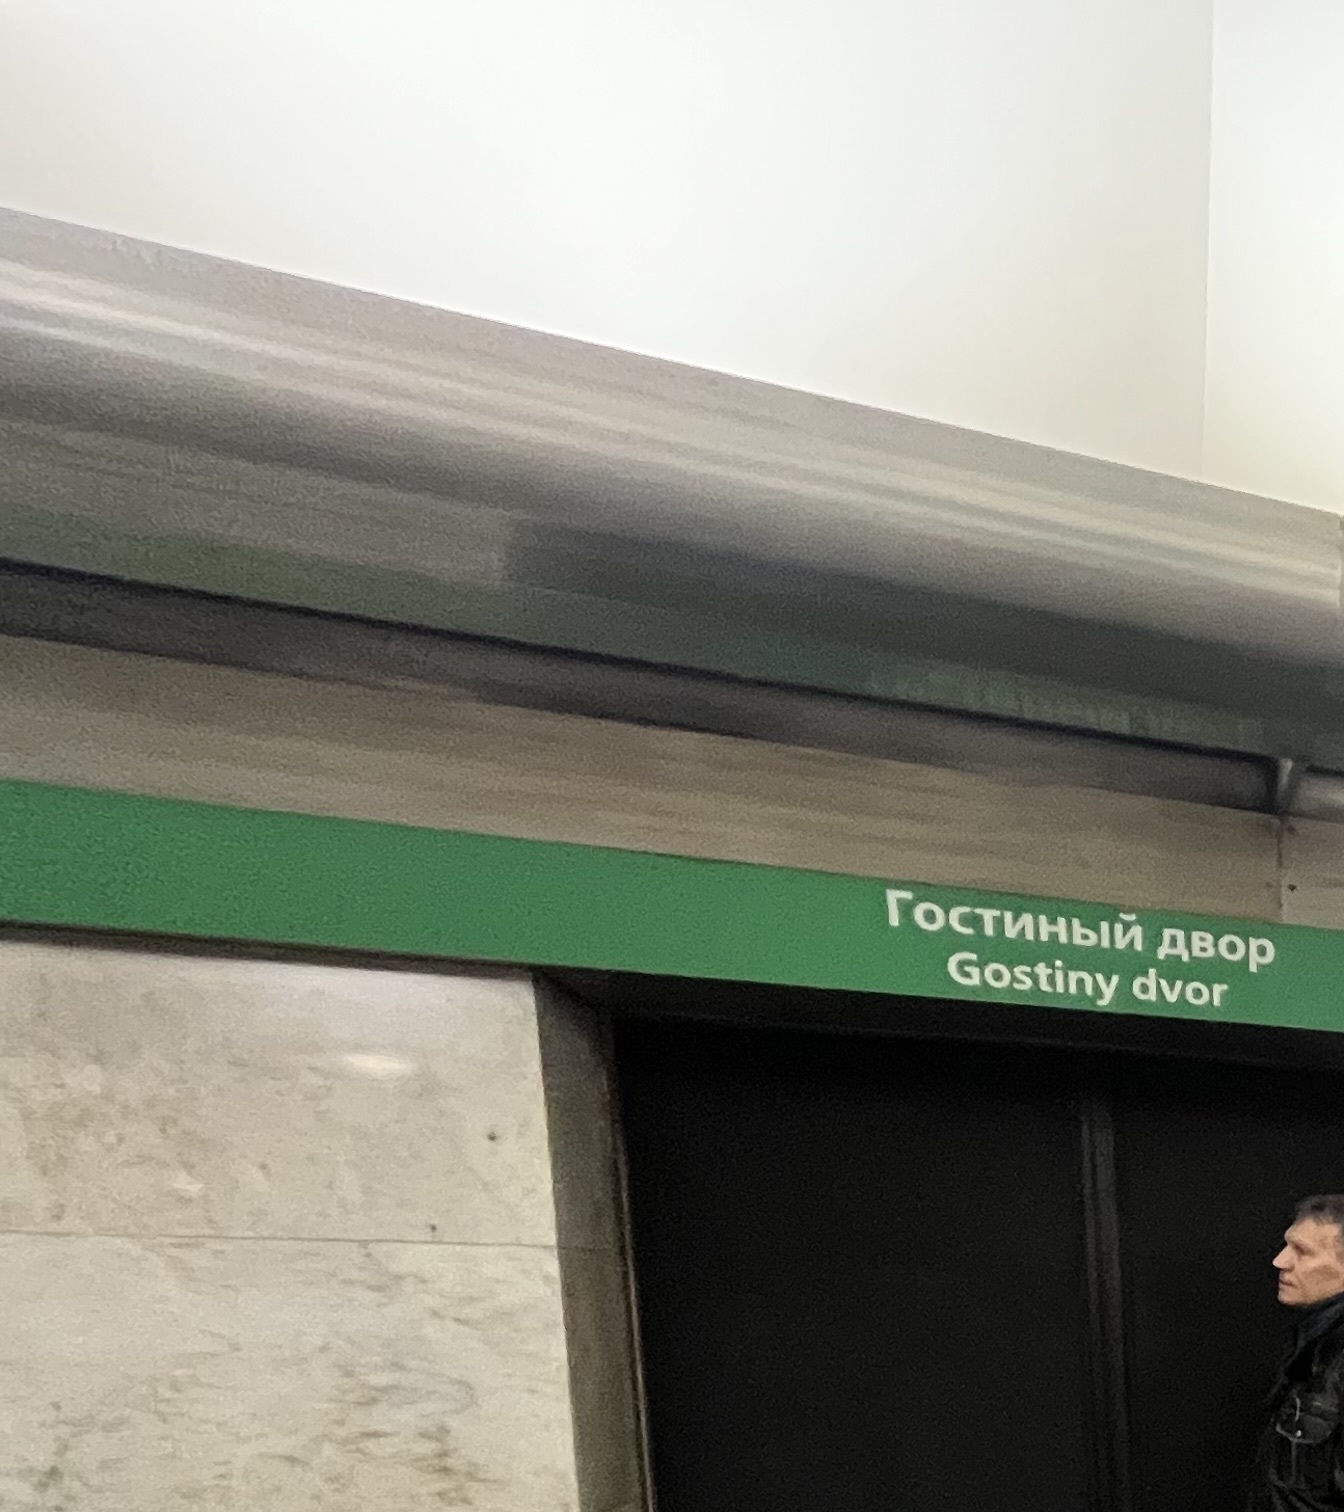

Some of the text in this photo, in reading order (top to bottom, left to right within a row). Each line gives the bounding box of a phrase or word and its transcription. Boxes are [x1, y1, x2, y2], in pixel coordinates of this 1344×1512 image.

[885, 888, 1276, 973] Гостиный двор
[946, 951, 1229, 1007] Gostiny dvor
